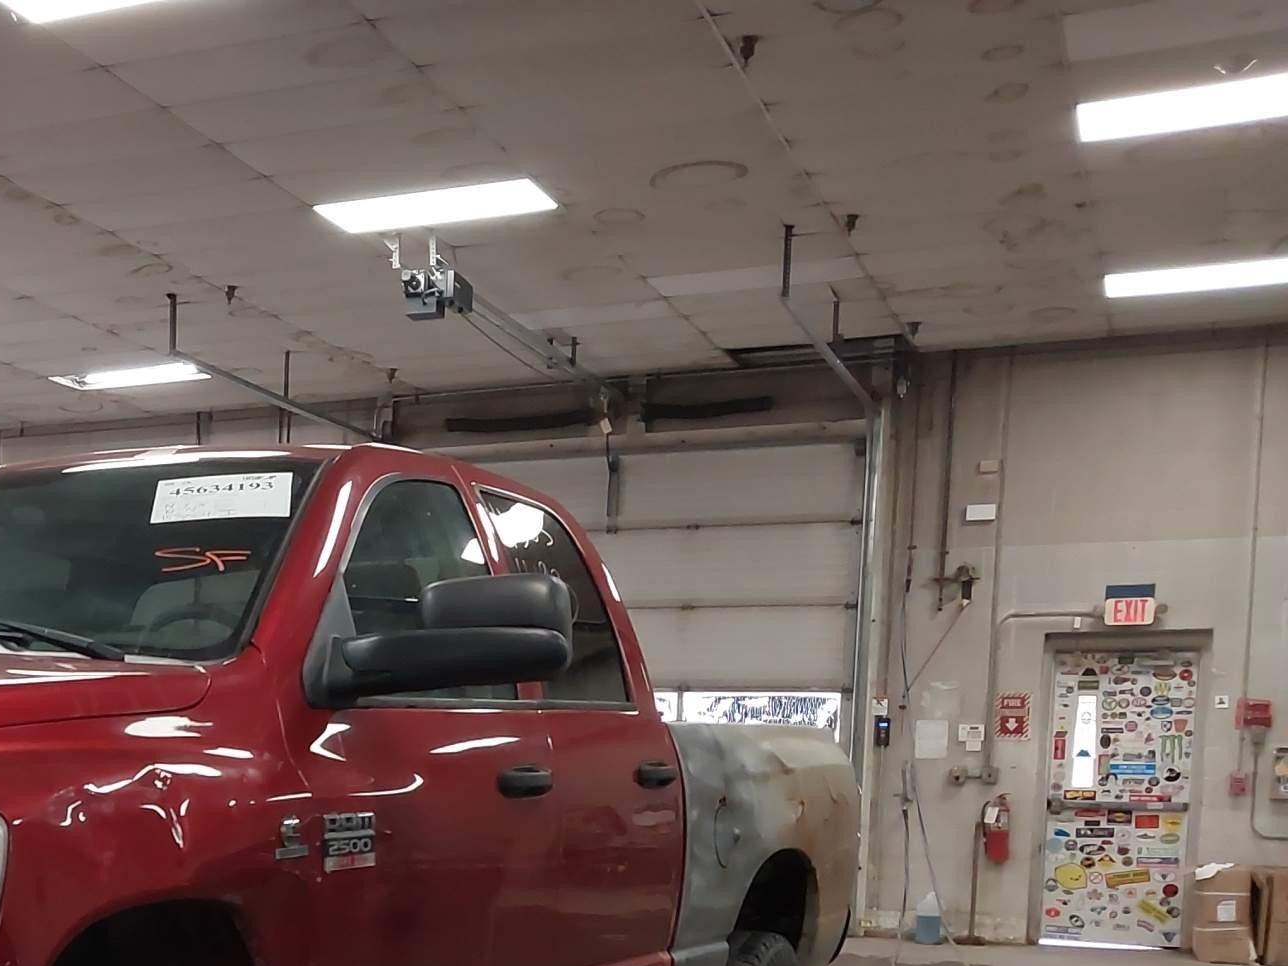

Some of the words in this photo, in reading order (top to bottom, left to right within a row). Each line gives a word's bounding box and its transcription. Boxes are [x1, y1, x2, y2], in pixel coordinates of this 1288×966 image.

[169, 481, 274, 496] 45634193
[154, 546, 252, 572] SF
[1113, 599, 1149, 623] EXIT
[1003, 698, 1022, 707] FIRE
[328, 838, 372, 856] 2500
